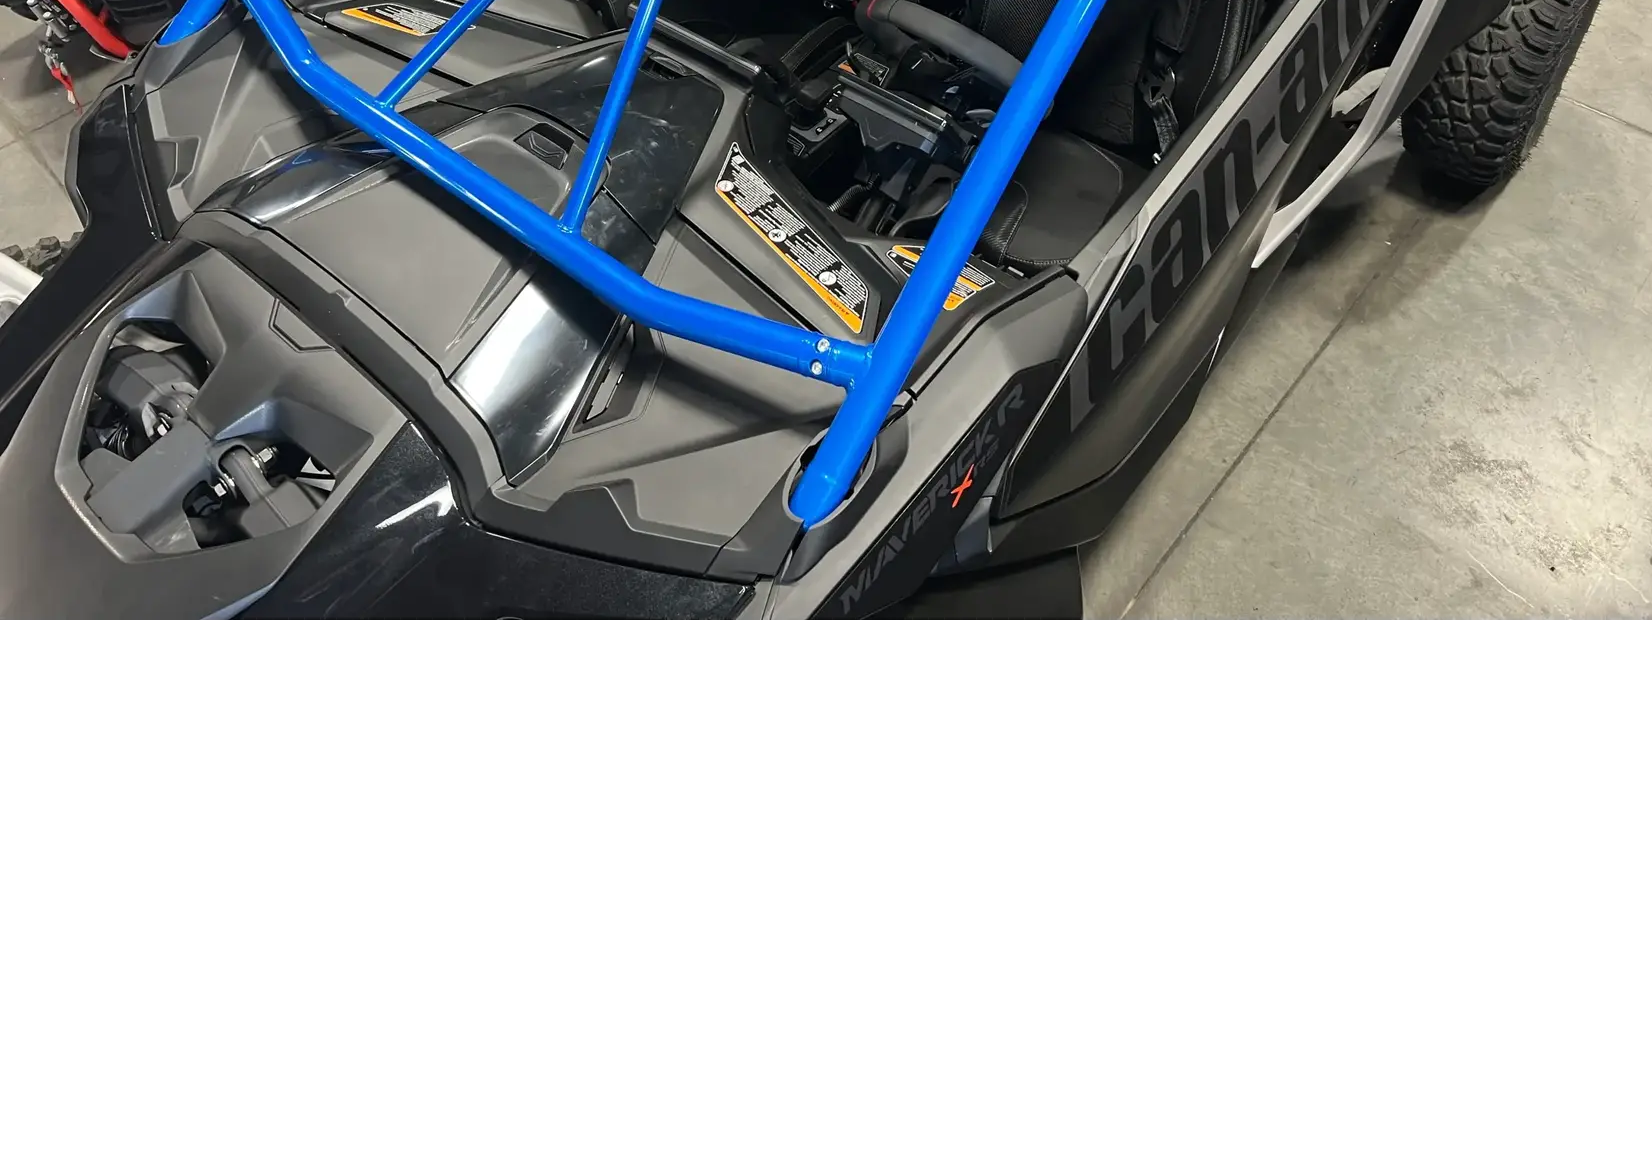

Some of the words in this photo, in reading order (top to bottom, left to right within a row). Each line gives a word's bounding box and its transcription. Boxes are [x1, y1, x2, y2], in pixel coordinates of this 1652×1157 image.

[838, 417, 999, 614] MAVERICK
[997, 382, 1026, 426] R
[950, 463, 975, 509] X
